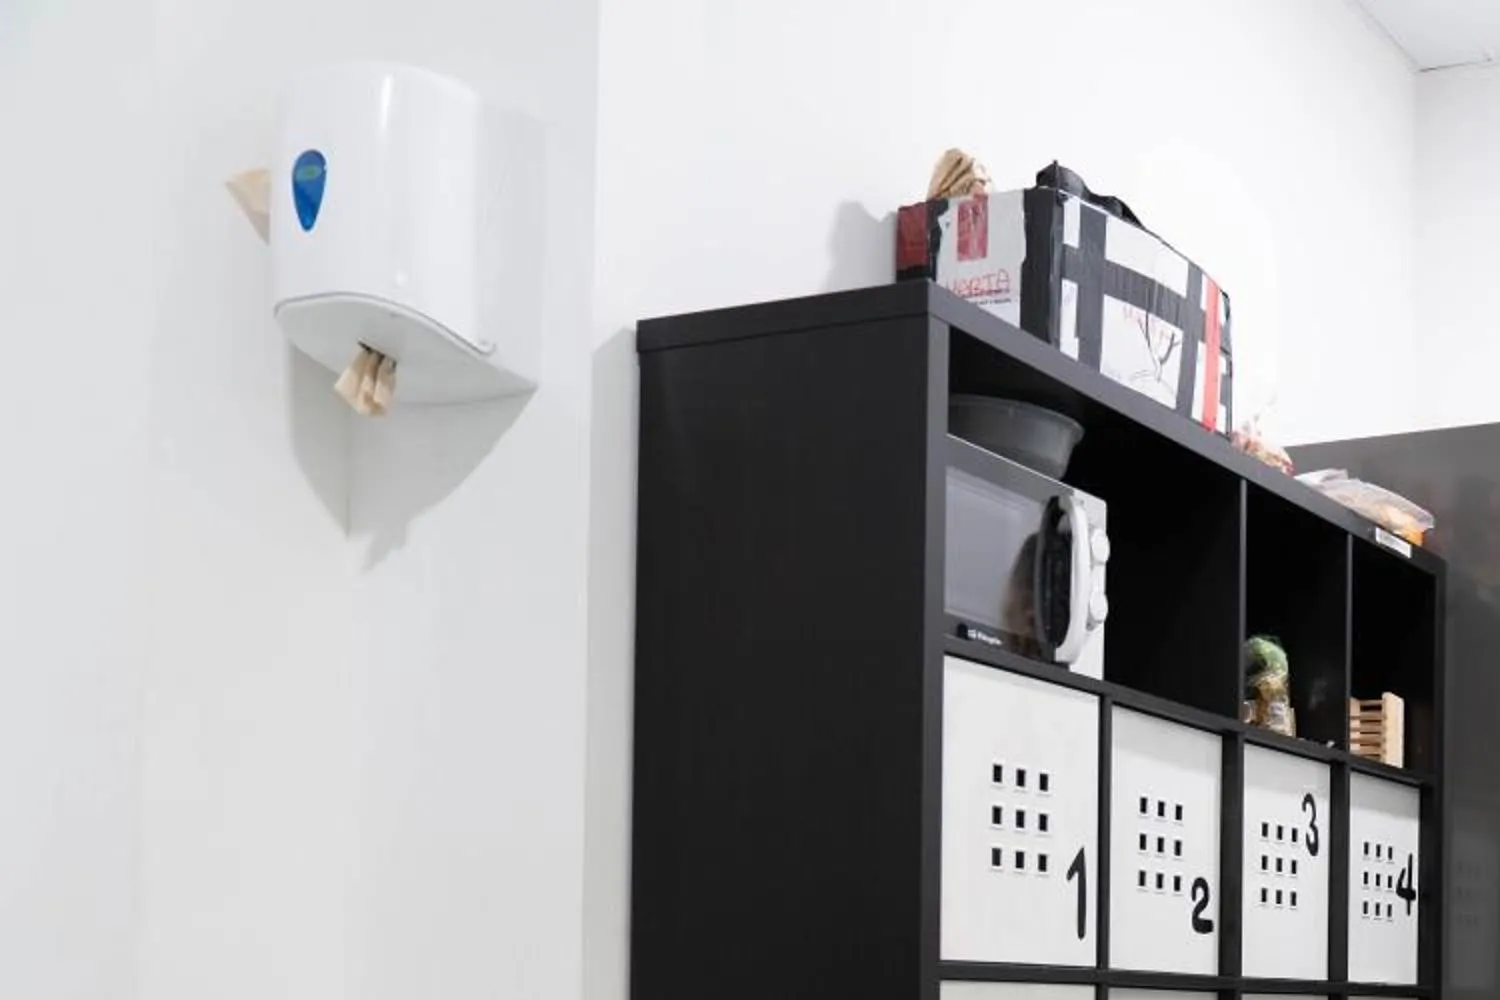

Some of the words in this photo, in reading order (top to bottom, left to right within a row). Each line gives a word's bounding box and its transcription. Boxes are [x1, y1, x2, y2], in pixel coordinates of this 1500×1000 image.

[1302, 793, 1319, 857] 3
[1066, 847, 1087, 940] 1
[1191, 877, 1214, 935] 2
[1395, 853, 1416, 916] 4
